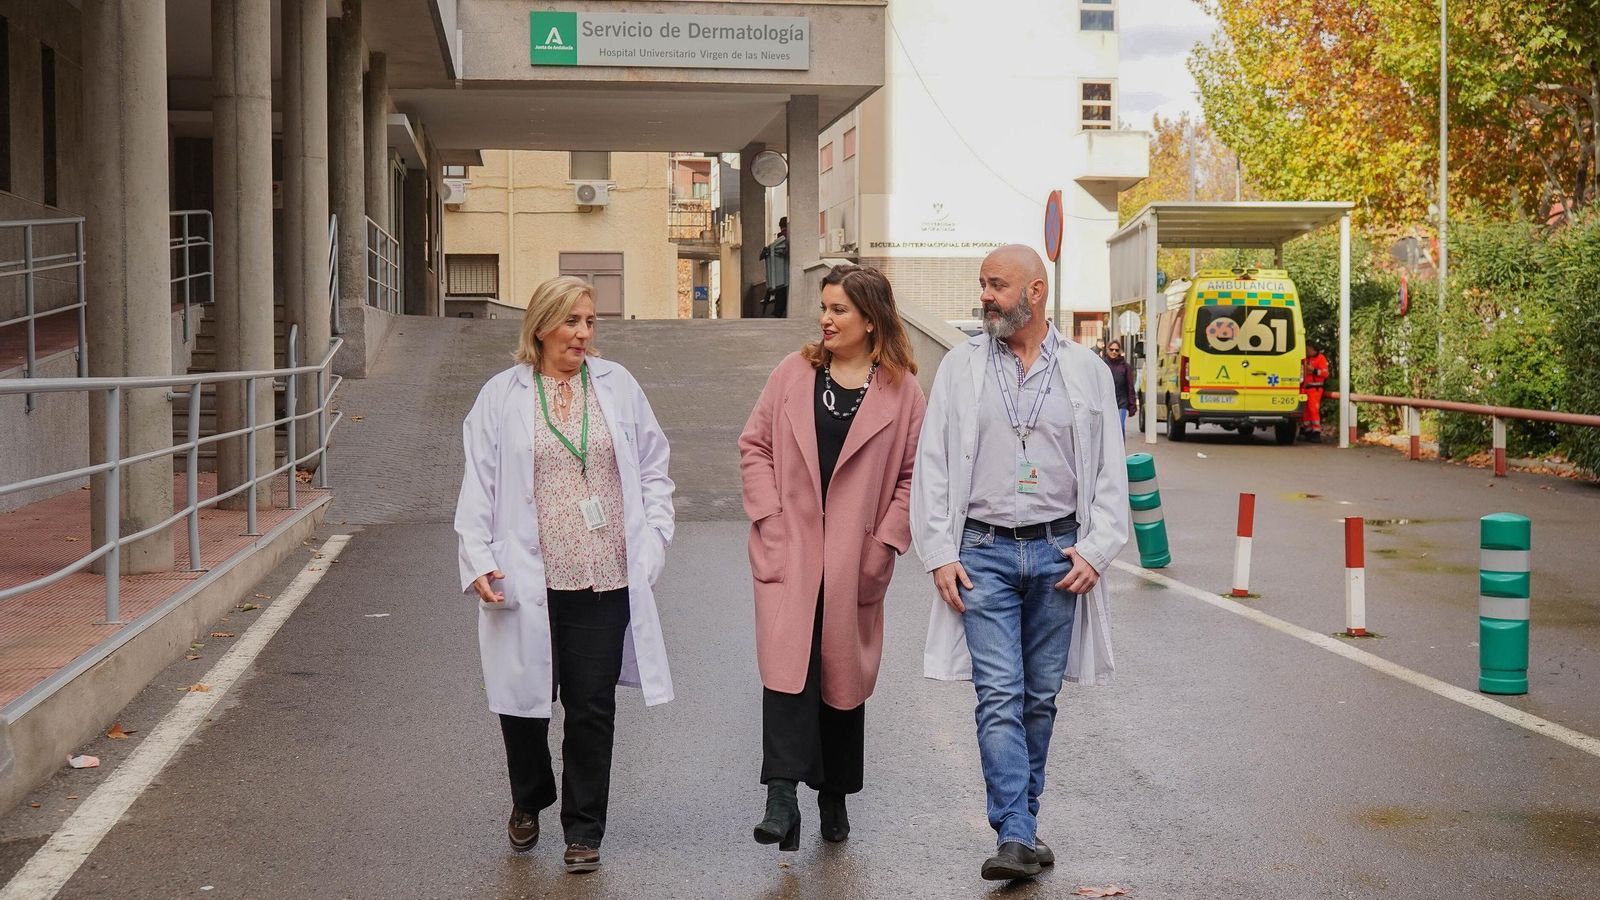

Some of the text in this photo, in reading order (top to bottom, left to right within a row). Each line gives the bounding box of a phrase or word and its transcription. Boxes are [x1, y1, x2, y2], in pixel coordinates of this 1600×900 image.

[582, 20, 804, 44] Servicio de Dermatología
[599, 48, 791, 60] Hospital Universitario Virgen de las Nieves
[1207, 280, 1285, 291] AMBULANCIA
[1272, 397, 1295, 405] E-265
